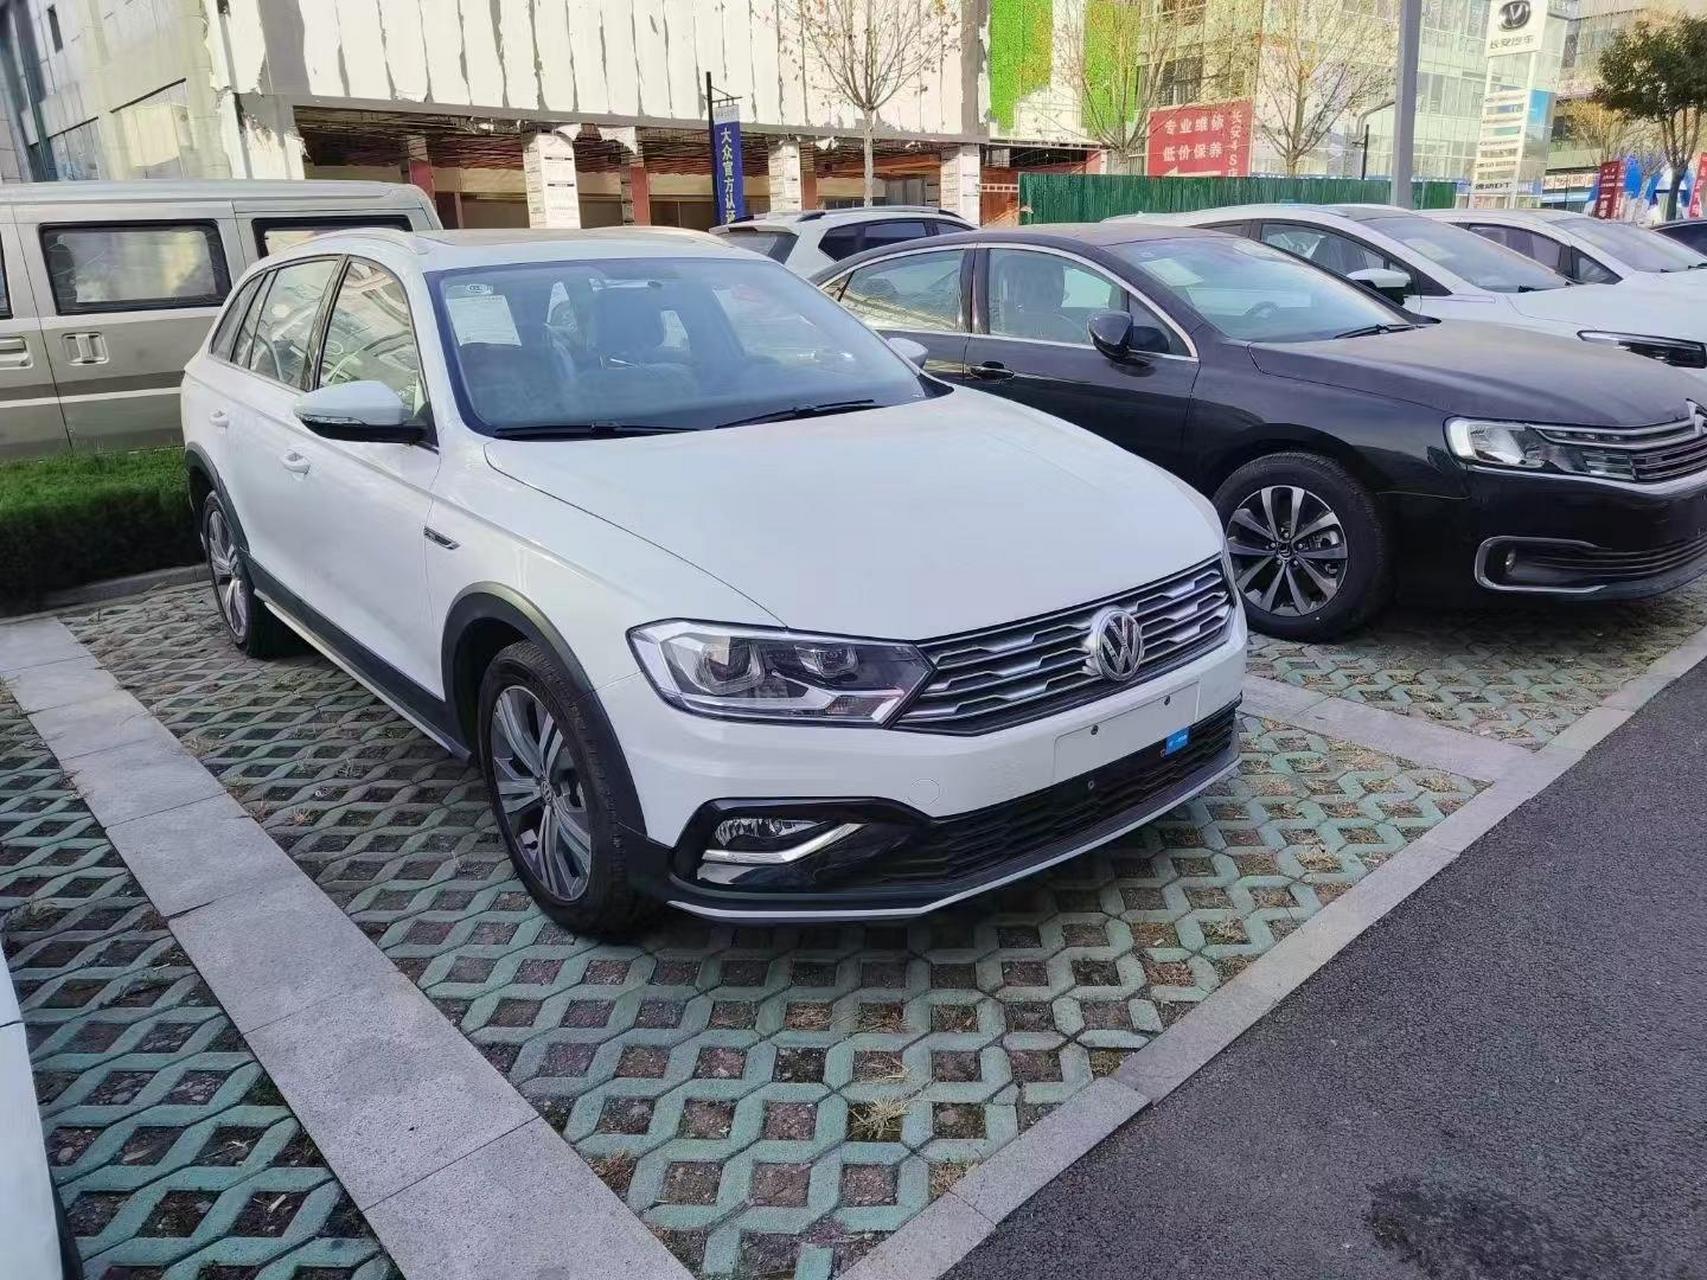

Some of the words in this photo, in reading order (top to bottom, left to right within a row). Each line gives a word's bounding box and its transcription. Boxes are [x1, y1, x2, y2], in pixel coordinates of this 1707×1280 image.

[1165, 114, 1224, 135] 专业维修
[1163, 142, 1222, 161] 低价保养
